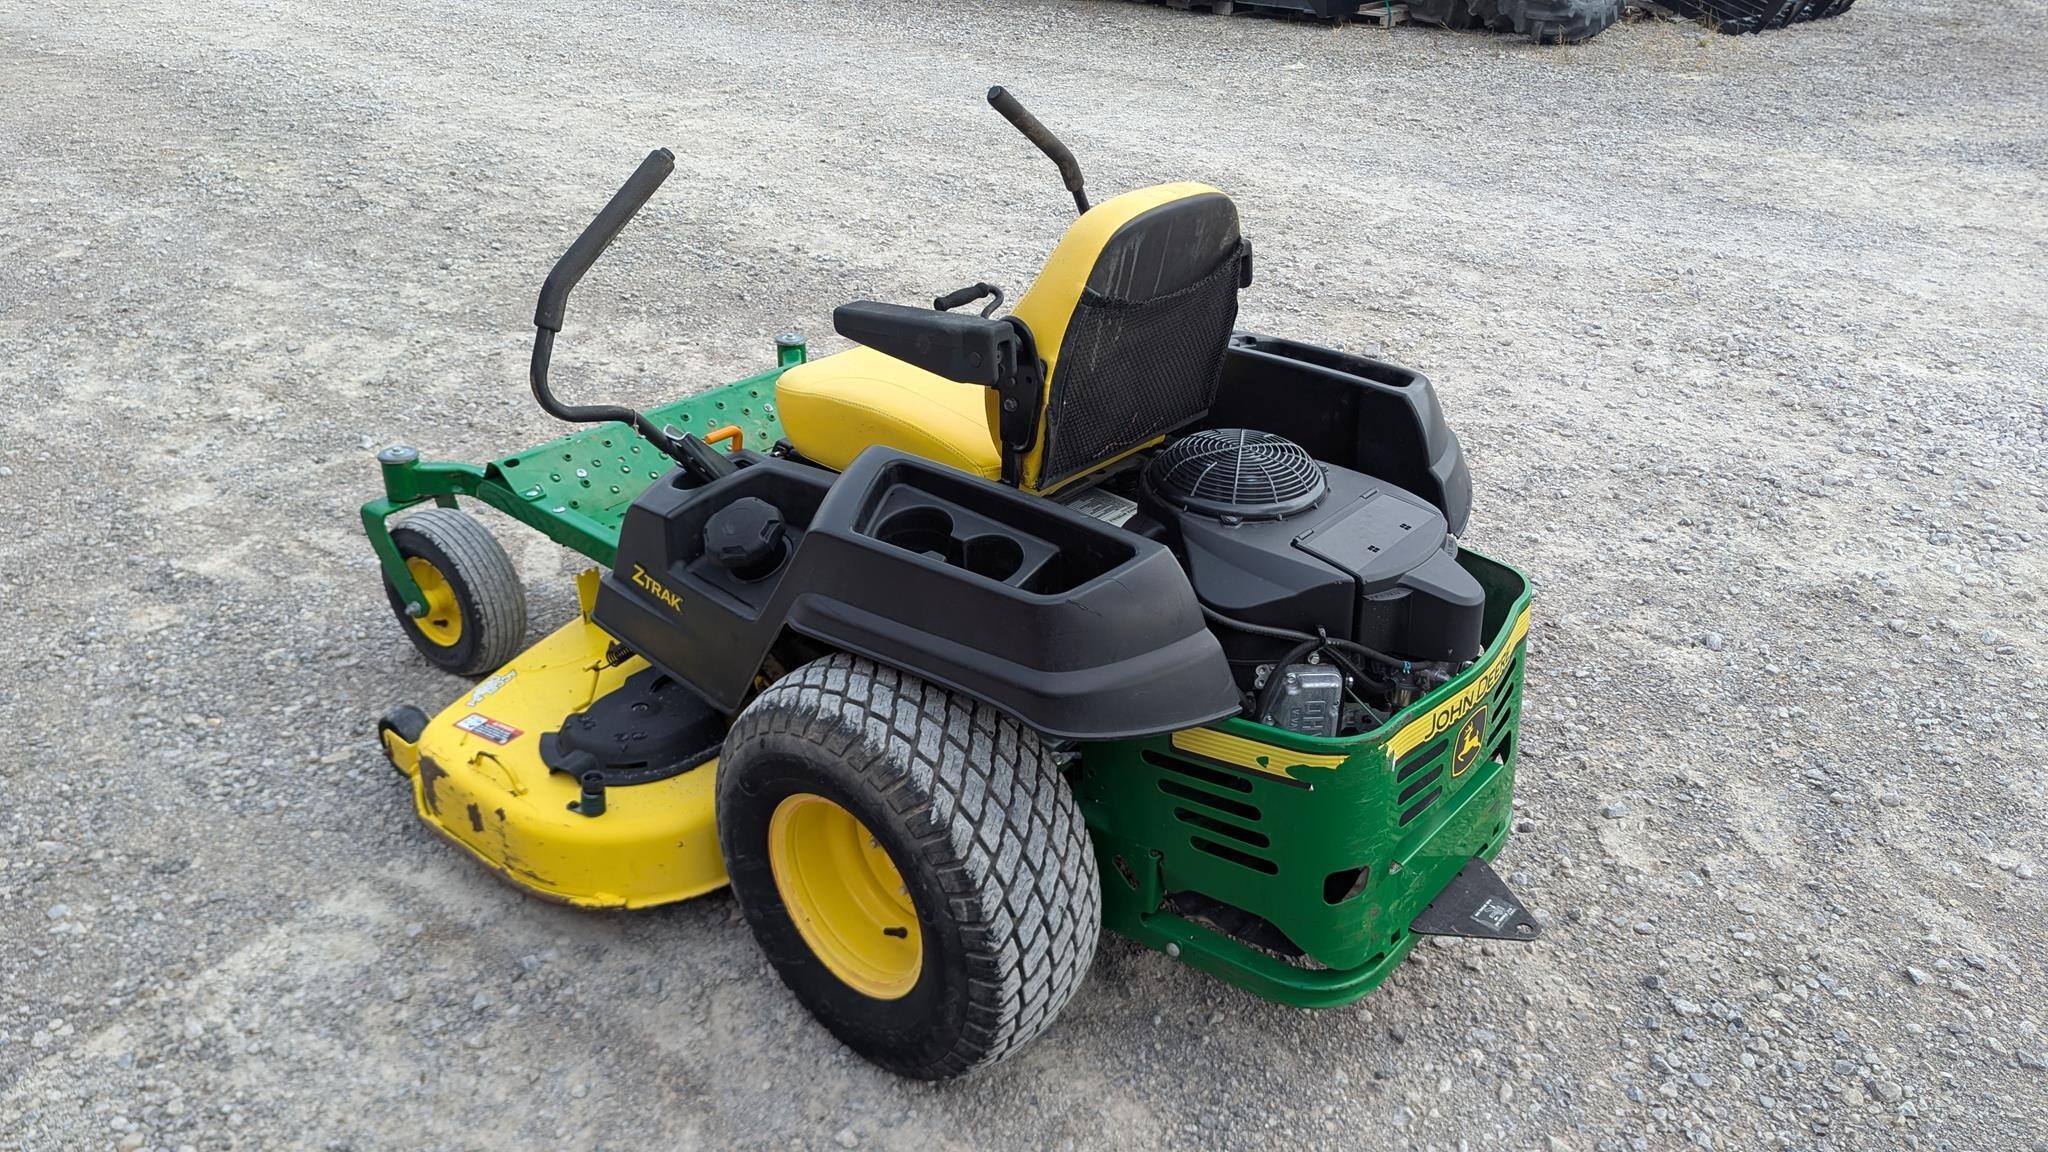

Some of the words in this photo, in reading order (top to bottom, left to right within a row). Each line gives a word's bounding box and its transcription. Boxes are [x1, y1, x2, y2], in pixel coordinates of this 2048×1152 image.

[631, 563, 683, 612] ZTRAK
[1424, 690, 1475, 740] JOHN
[1477, 643, 1512, 701] DEERE
